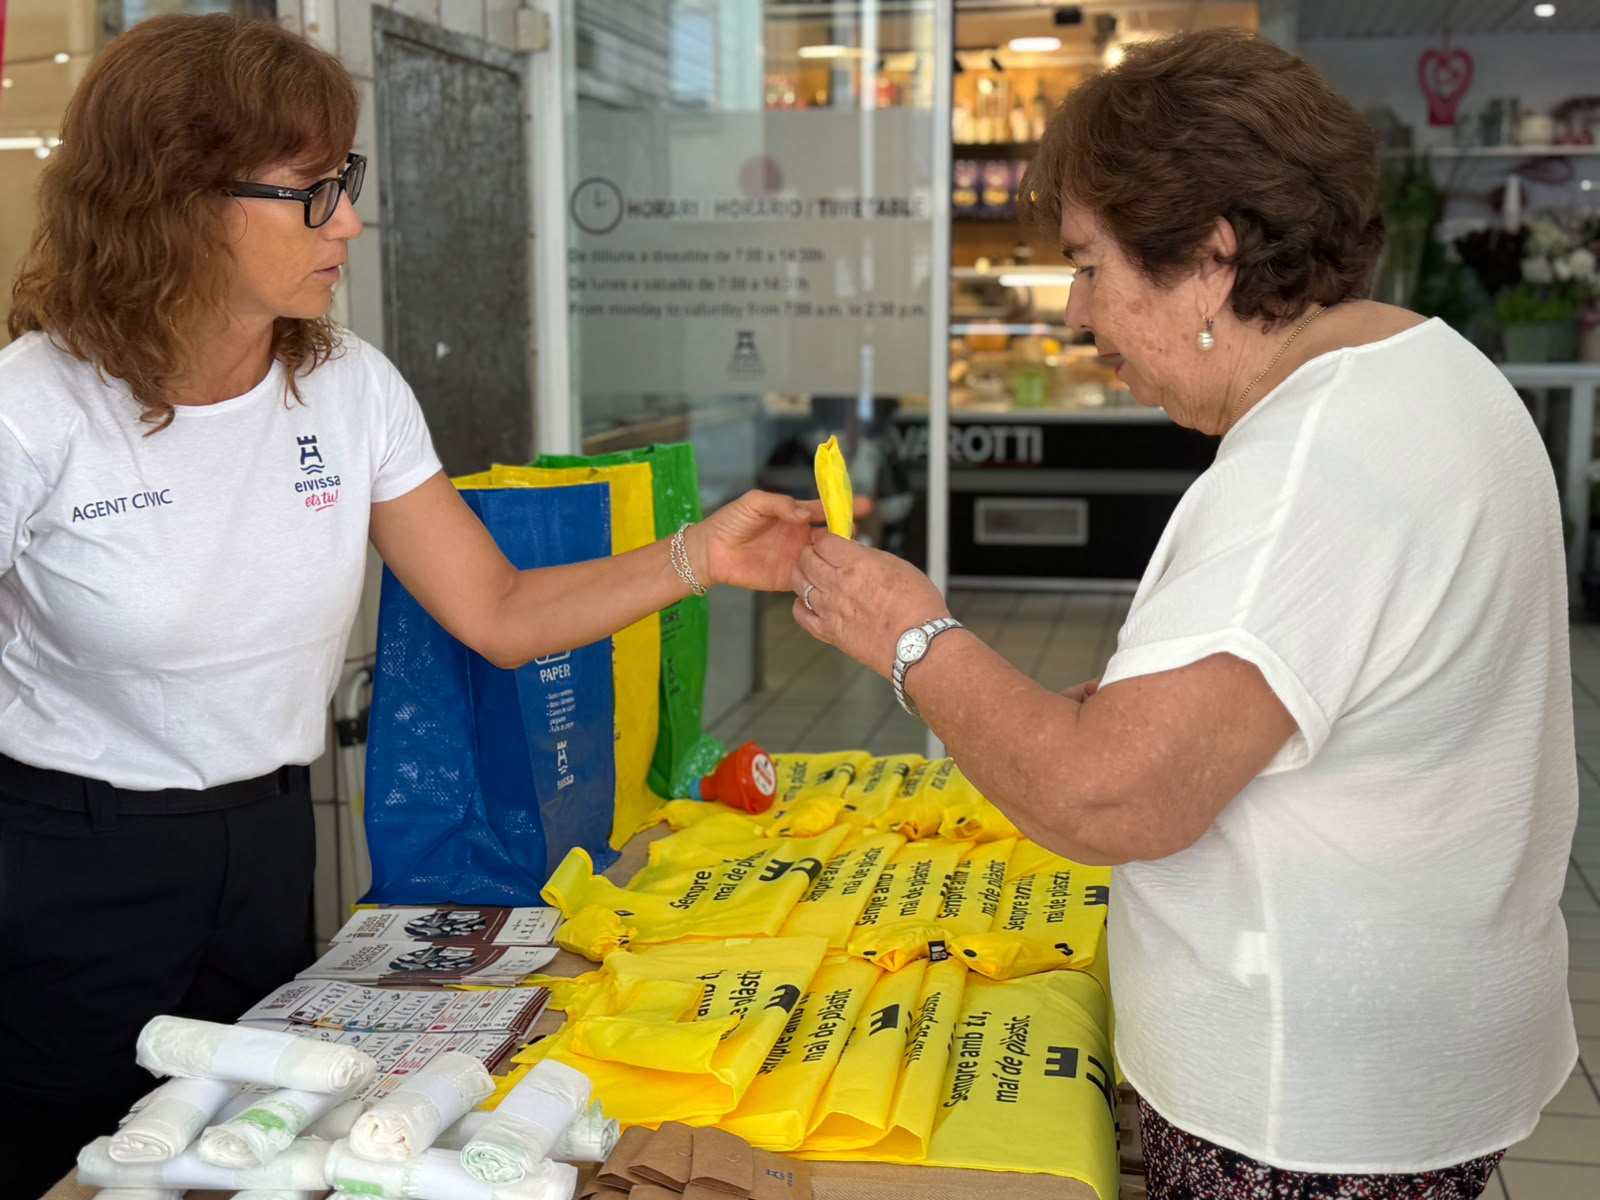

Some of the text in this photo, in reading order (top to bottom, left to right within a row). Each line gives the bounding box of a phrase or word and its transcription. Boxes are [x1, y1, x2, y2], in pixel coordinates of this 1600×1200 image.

[295, 475, 341, 493] eivissa
[72, 497, 128, 523] AGENT
[539, 663, 571, 683] PAPER
[669, 870, 713, 910] Sempre
[713, 867, 748, 901] mai de
[855, 896, 889, 926] Sempre
[807, 1022, 838, 1039] de
[801, 1040, 831, 1063] mai
[943, 1011, 993, 1108] Sempre amb tu,
[992, 1015, 1031, 1103] mai de plàstic.
